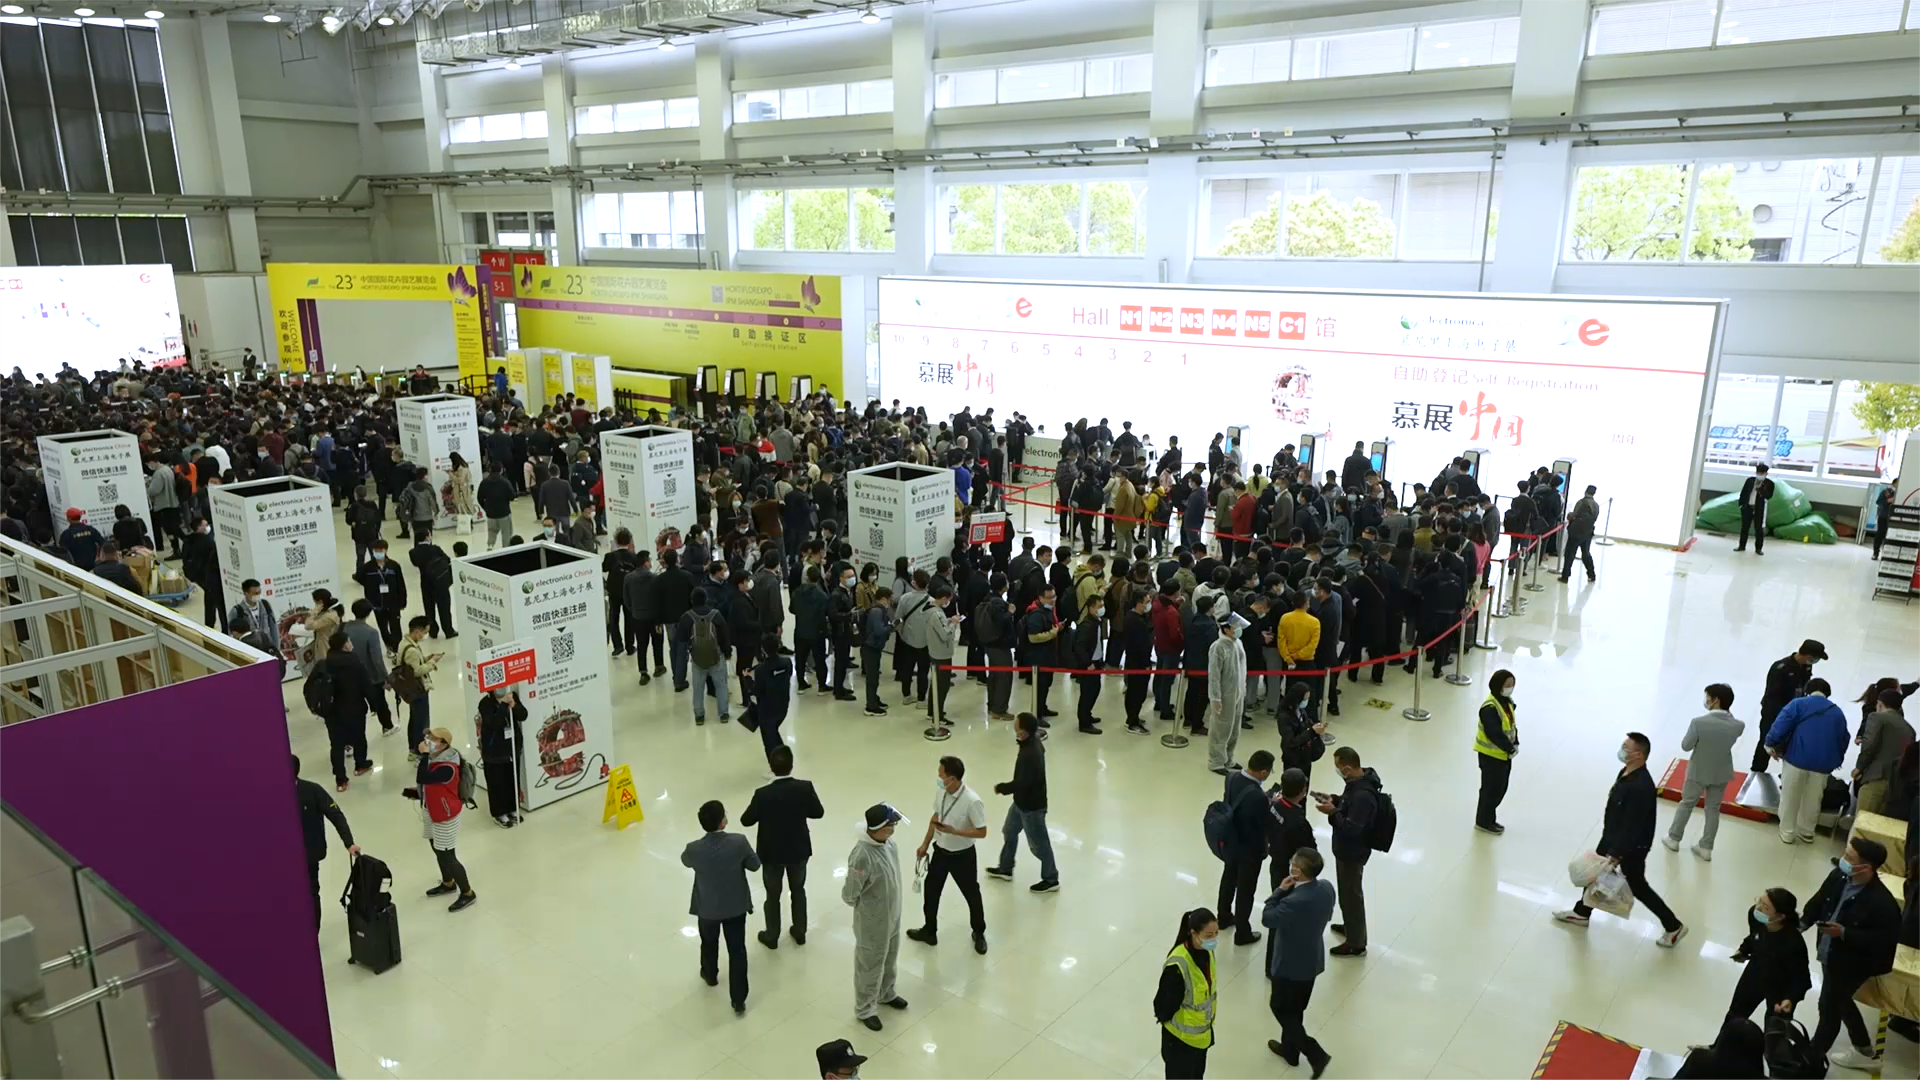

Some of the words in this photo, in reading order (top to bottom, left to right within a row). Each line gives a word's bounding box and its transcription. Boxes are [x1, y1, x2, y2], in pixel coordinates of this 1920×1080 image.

[498, 258, 505, 267] W
[1072, 307, 1109, 326] Hall
[1120, 310, 1142, 326] N1
[1150, 310, 1172, 327] N2
[1180, 312, 1204, 328] N3
[1212, 313, 1237, 330] N4
[1245, 314, 1270, 332] N5
[1315, 316, 1336, 338] 馆
[733, 327, 806, 344] 自助换证区
[922, 335, 930, 346] 9
[952, 337, 959, 348] 8
[981, 340, 989, 350] 7
[1011, 342, 1019, 353] 6
[1042, 344, 1050, 355] 5
[1074, 346, 1082, 357] 4
[1108, 348, 1117, 360] 3
[1143, 350, 1152, 363] 2
[1181, 353, 1187, 365] 1
[1394, 365, 1468, 385] 自助登记
[1507, 376, 1599, 392] Registration
[1392, 390, 1524, 447] 慕展中国
[269, 498, 303, 508] electronica
[258, 504, 322, 522] 慕尼黑上海电子展
[859, 506, 893, 519] 微信快速注册
[915, 504, 945, 518] 微信快速注册
[266, 521, 317, 537] 微信快速注册
[467, 575, 490, 588] electronica
[536, 574, 572, 587] electronica
[574, 568, 593, 578] China
[461, 585, 505, 608] 慕尼黑上海电子展
[524, 581, 594, 607] 慕尼黑上海电子展
[466, 605, 501, 626] 微信快速注册
[532, 602, 587, 625] 微信快速注册
[533, 622, 551, 631] VISITOR
[553, 613, 587, 625] REGISTRATION
